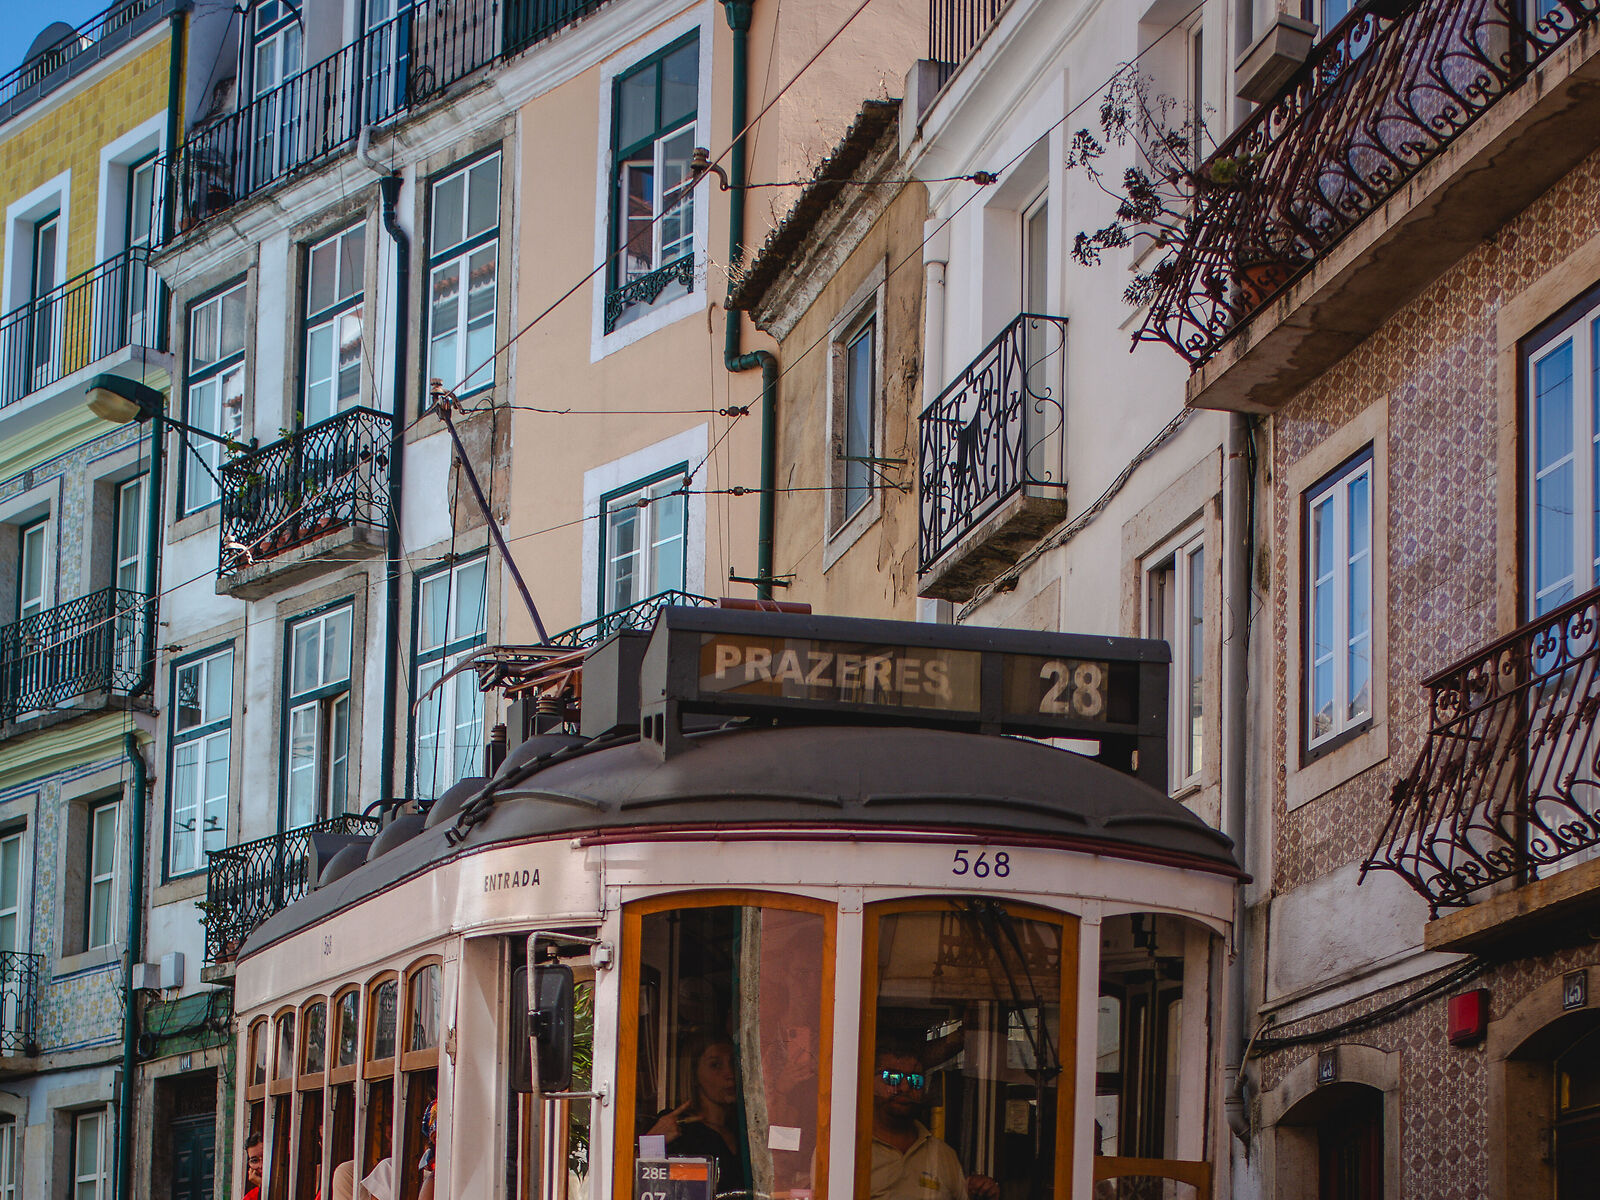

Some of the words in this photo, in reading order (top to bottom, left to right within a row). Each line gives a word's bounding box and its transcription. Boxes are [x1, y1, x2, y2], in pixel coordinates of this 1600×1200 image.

[715, 644, 950, 697] PRAZERES
[1038, 660, 1102, 717] 28
[952, 849, 1010, 878] 568
[484, 868, 540, 893] ENTRADA
[323, 935, 332, 956] 568
[641, 1166, 667, 1180] 28E
